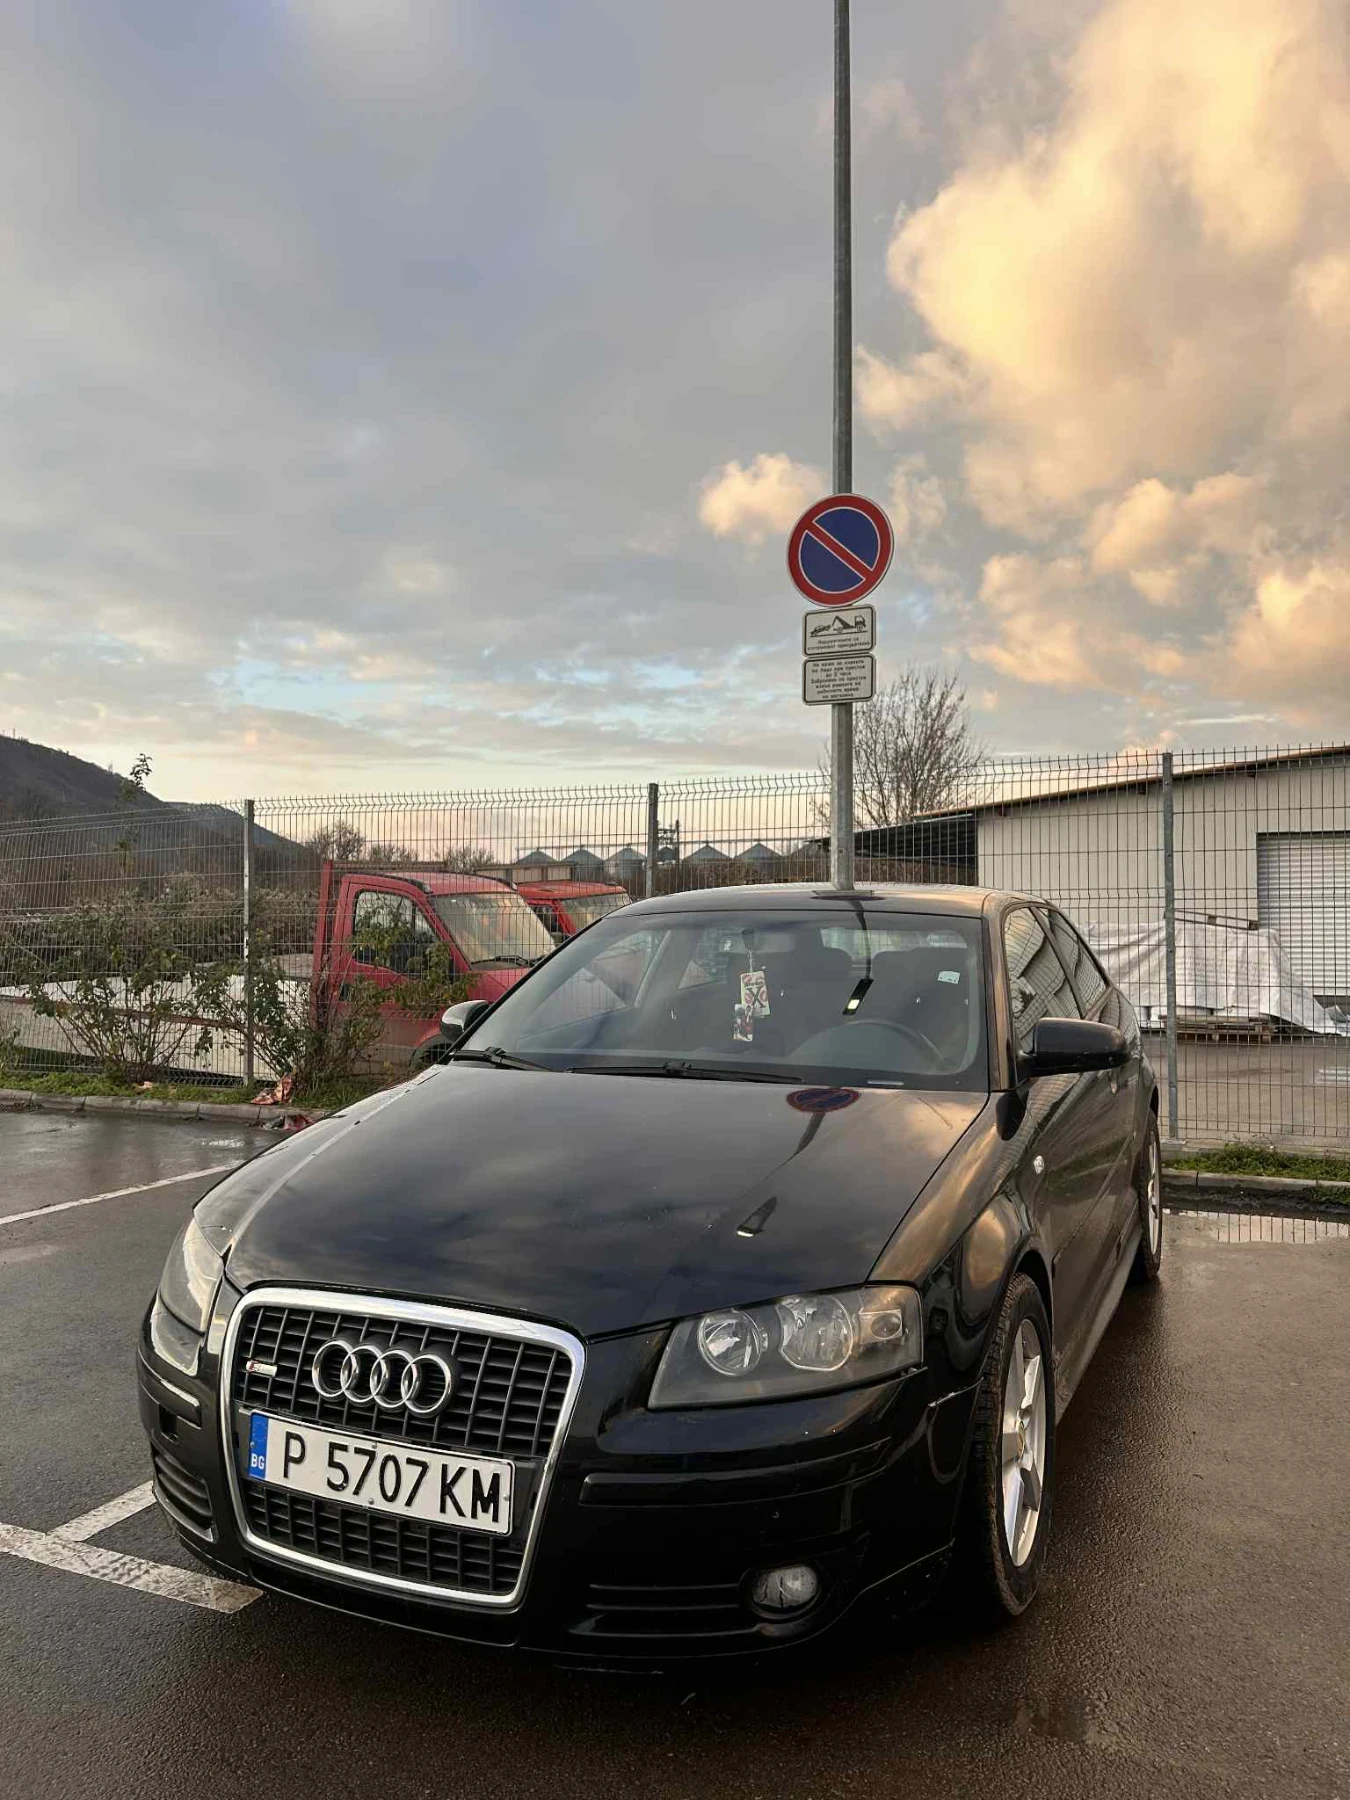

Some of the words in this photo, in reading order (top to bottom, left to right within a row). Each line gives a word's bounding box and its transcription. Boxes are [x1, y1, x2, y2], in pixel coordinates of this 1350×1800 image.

[251, 1453, 265, 1470] BG
[283, 1431, 306, 1479] P
[326, 1442, 429, 1507] 5707
[439, 1463, 500, 1523] KM
